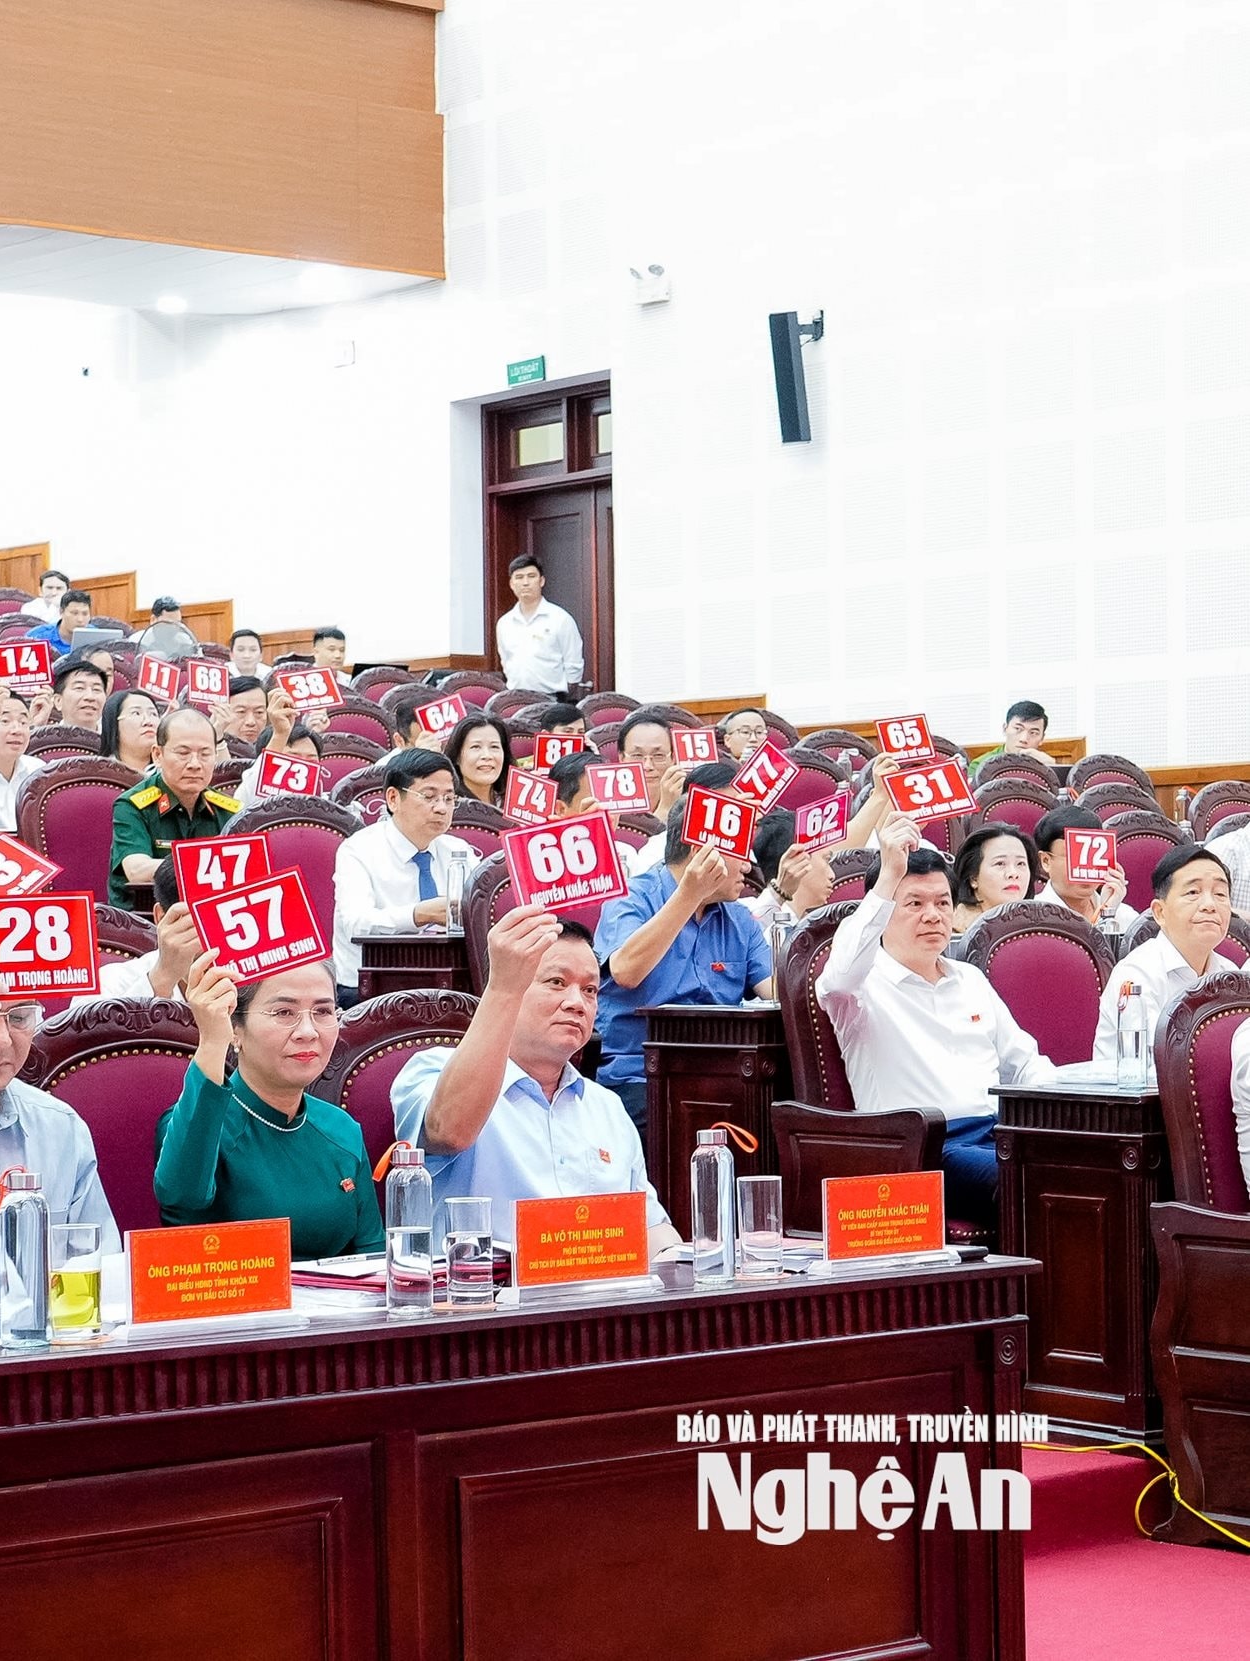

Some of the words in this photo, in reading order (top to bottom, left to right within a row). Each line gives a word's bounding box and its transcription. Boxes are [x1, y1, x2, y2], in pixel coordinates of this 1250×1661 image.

[1, 647, 39, 674] 14
[148, 662, 170, 689] 11
[195, 666, 222, 693] 68
[290, 673, 327, 698] 38
[428, 702, 459, 731] 64
[681, 733, 710, 758] 15
[887, 720, 922, 748] 65
[545, 739, 574, 765] 81
[272, 757, 308, 790] 73
[597, 768, 636, 798] 78
[742, 752, 778, 795] 77
[903, 769, 953, 804] 31
[517, 776, 547, 812] 74
[702, 798, 742, 837] 16
[806, 801, 839, 838] 62
[527, 824, 598, 883] 66
[1075, 835, 1109, 866] 72
[196, 843, 251, 891] 47
[530, 881, 565, 906] NGUYỄN
[215, 884, 285, 951] 57
[240, 956, 259, 973] THỊ
[258, 945, 289, 967] MINH
[288, 936, 317, 957] SINH
[18, 971, 51, 989] TRỌNG
[53, 966, 88, 984] HOÀNG
[838, 1209, 855, 1221] ÔNG
[541, 1232, 552, 1243] BÀ
[568, 1230, 580, 1242] THỊ
[582, 1229, 603, 1240] MINH
[605, 1227, 623, 1238] SINH
[148, 1265, 170, 1278] ÔNG
[173, 1263, 201, 1277] PHẠM
[204, 1261, 238, 1275] TRỌNG
[241, 1256, 275, 1270] HOÀNG
[248, 1275, 258, 1284] XIX
[238, 1288, 245, 1297] 17
